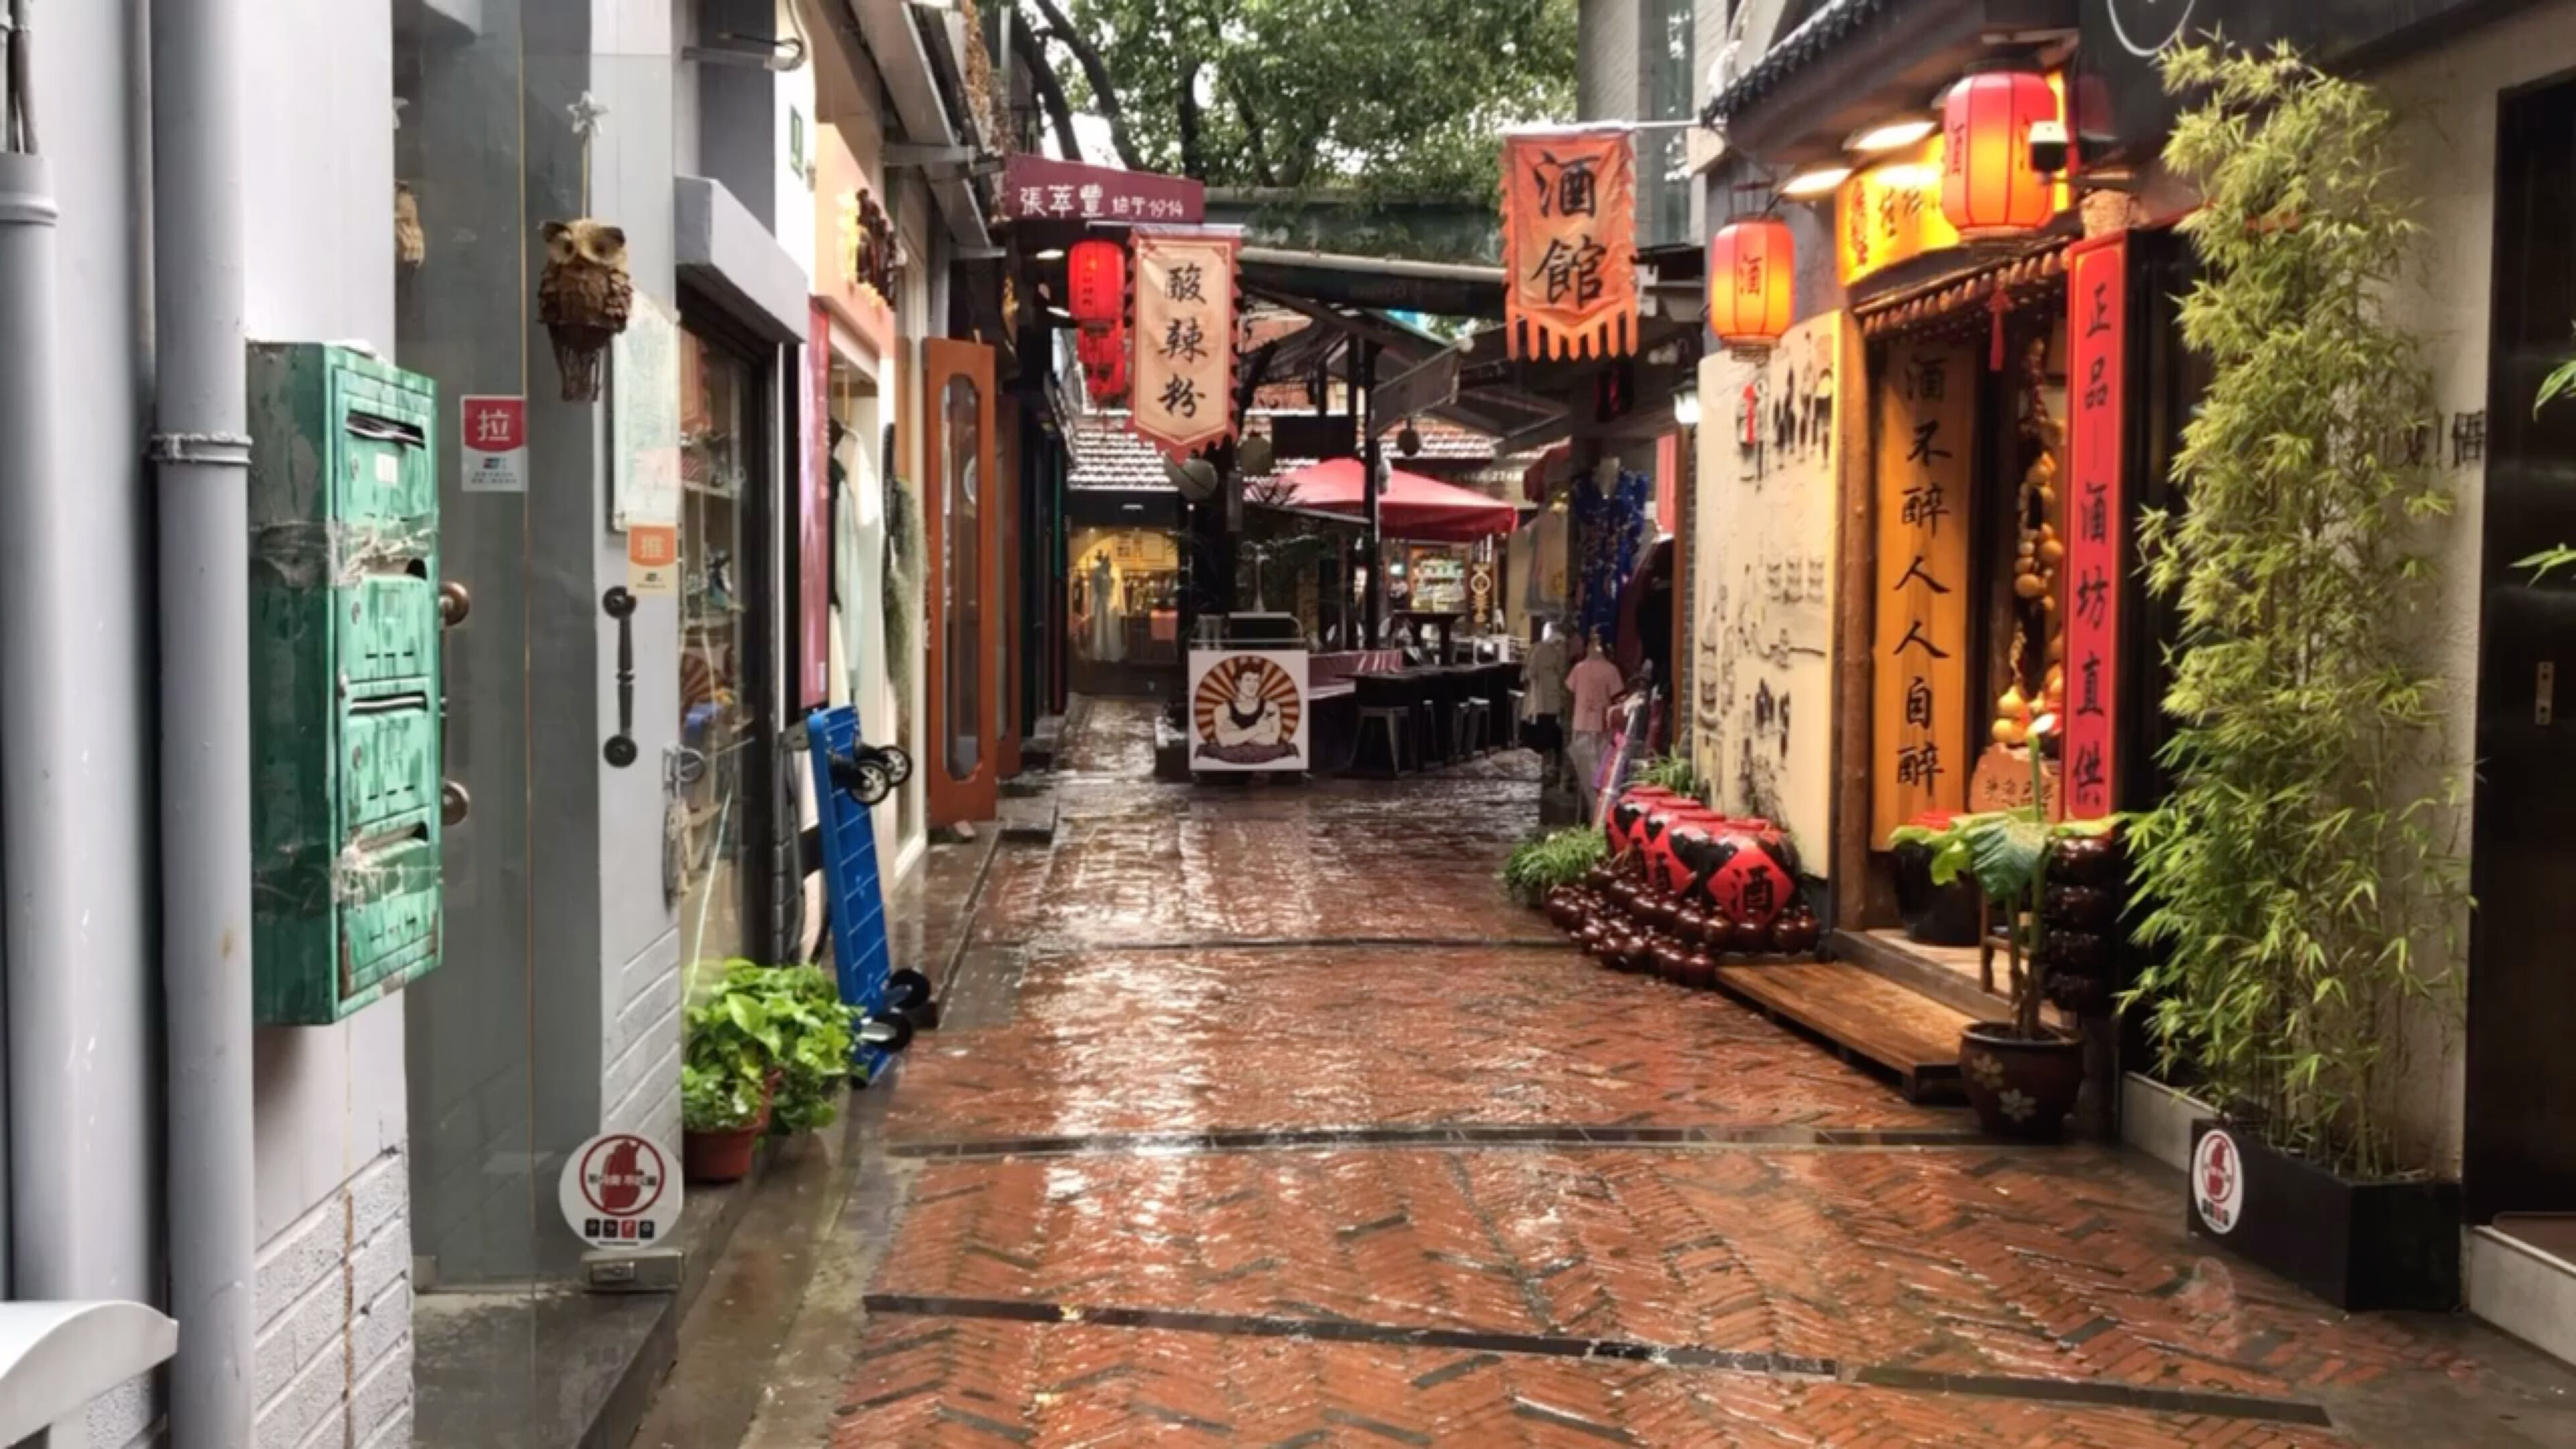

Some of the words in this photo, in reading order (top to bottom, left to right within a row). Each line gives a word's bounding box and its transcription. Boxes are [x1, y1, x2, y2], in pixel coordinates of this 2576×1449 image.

[1531, 149, 1607, 310] 酒館
[1157, 262, 1208, 419] 酸辣粉
[477, 408, 511, 441] 拉
[1893, 353, 1952, 797] 酒不醉人人自醉
[1729, 865, 1774, 914] 酒
